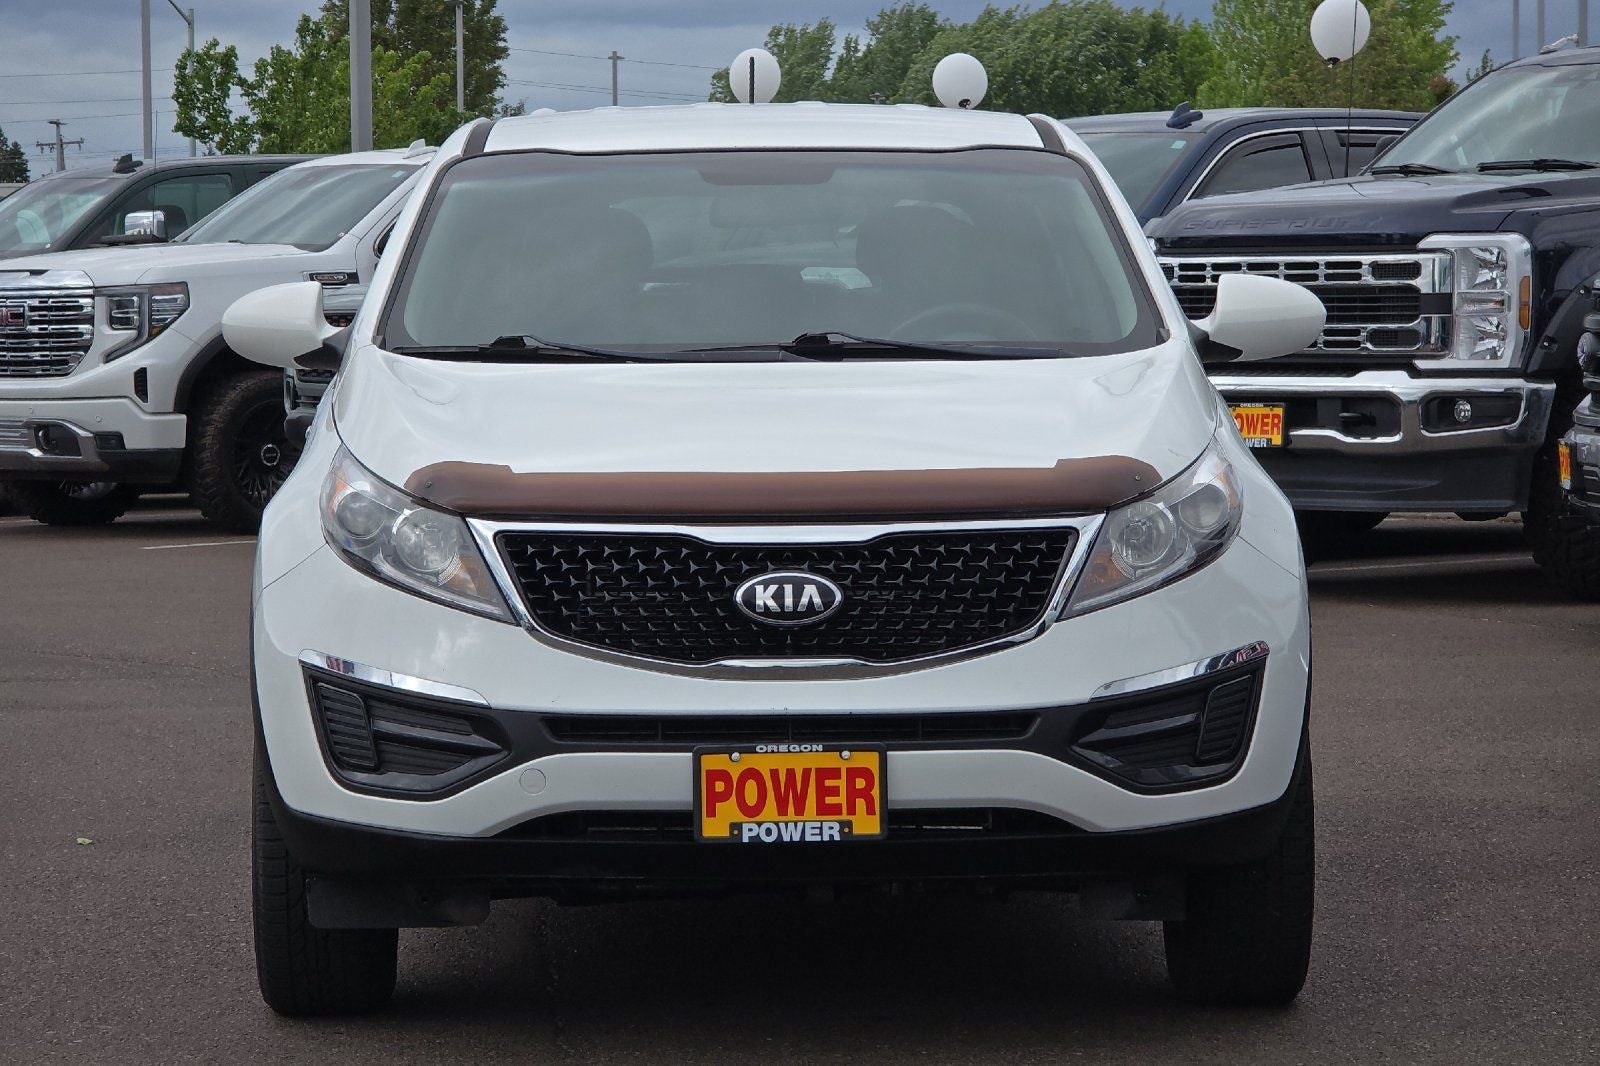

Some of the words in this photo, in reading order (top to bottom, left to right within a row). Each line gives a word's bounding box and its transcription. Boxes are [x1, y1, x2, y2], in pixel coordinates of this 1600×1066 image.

[1233, 412, 1282, 435] OWER
[1245, 438, 1267, 448] WER
[754, 584, 825, 613] KIA
[755, 744, 824, 753] OREGON
[705, 766, 877, 819] POWER
[741, 821, 841, 843] POWER
